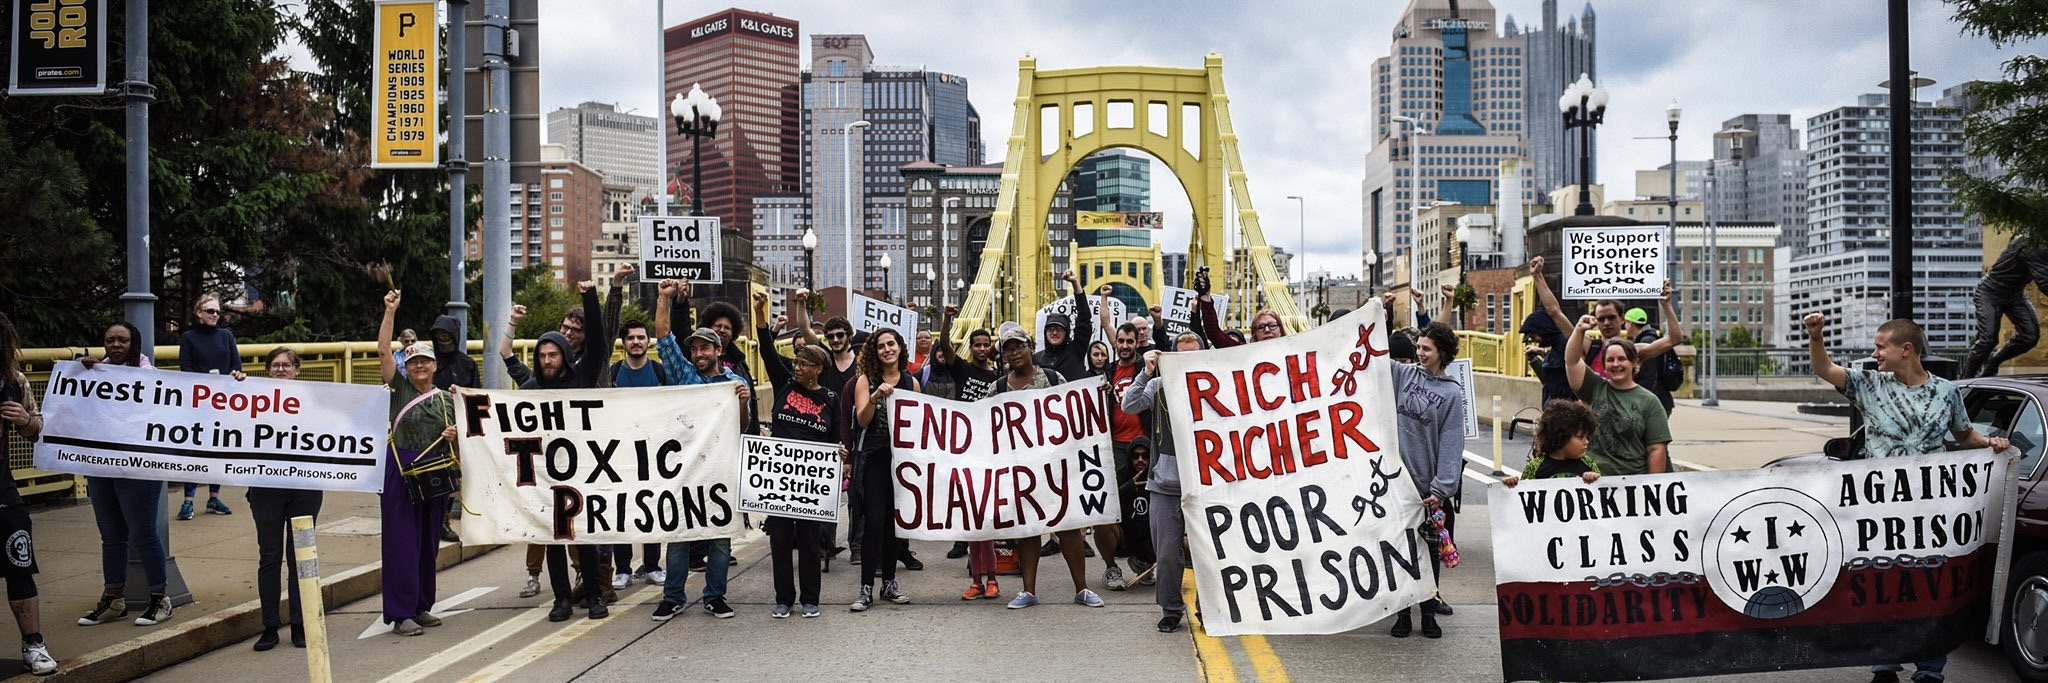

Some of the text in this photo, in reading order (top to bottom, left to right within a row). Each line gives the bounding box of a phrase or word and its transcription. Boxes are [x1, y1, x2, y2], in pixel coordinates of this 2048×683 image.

[59, 0, 87, 49] RO
[399, 12, 416, 37] P
[691, 18, 728, 39] K&L GATES
[740, 18, 794, 38] K&L GATES
[823, 36, 850, 49] EQT
[388, 49, 425, 61] WORLD
[37, 69, 80, 77] pirates.com
[388, 63, 425, 74] SERIES
[400, 76, 425, 86] 1909
[400, 90, 425, 100] 1925
[387, 76, 397, 141] CHAMPIONS
[400, 104, 425, 114] 1960
[400, 117, 424, 127] 1971
[400, 131, 425, 141] 1979
[653, 219, 700, 242] End
[1569, 231, 1660, 246] We Support
[654, 245, 700, 259] Prison
[1571, 245, 1659, 259] Prisoners
[654, 264, 702, 280] Slavery
[1574, 260, 1655, 275] On Strike
[865, 300, 902, 327] End
[1185, 322, 1390, 422] RICH get
[52, 371, 301, 419] Invest in People
[1427, 391, 1447, 410] CITY
[461, 393, 604, 438] FIGHT
[777, 413, 827, 433] STOLEN LAND
[893, 386, 1108, 455] END PRISON
[145, 421, 374, 455] not in Prisons
[1194, 401, 1380, 486] RICHER
[504, 436, 683, 487] TOXIC
[747, 440, 838, 462] We Support
[747, 455, 835, 479] Prisoners
[749, 473, 831, 496] On Strike
[1078, 444, 1108, 516] NOW
[1838, 460, 1994, 507] AGAINST
[894, 459, 1069, 531] SLAVERY
[1518, 481, 1688, 524] WORKING
[550, 482, 733, 541] PRISONS
[1205, 455, 1402, 560] POOR get
[1856, 507, 1985, 552] PRISON
[1547, 529, 1689, 570] CLASS
[1221, 528, 1421, 623] PRISON
[1500, 586, 1710, 627] SOLIDARITY
